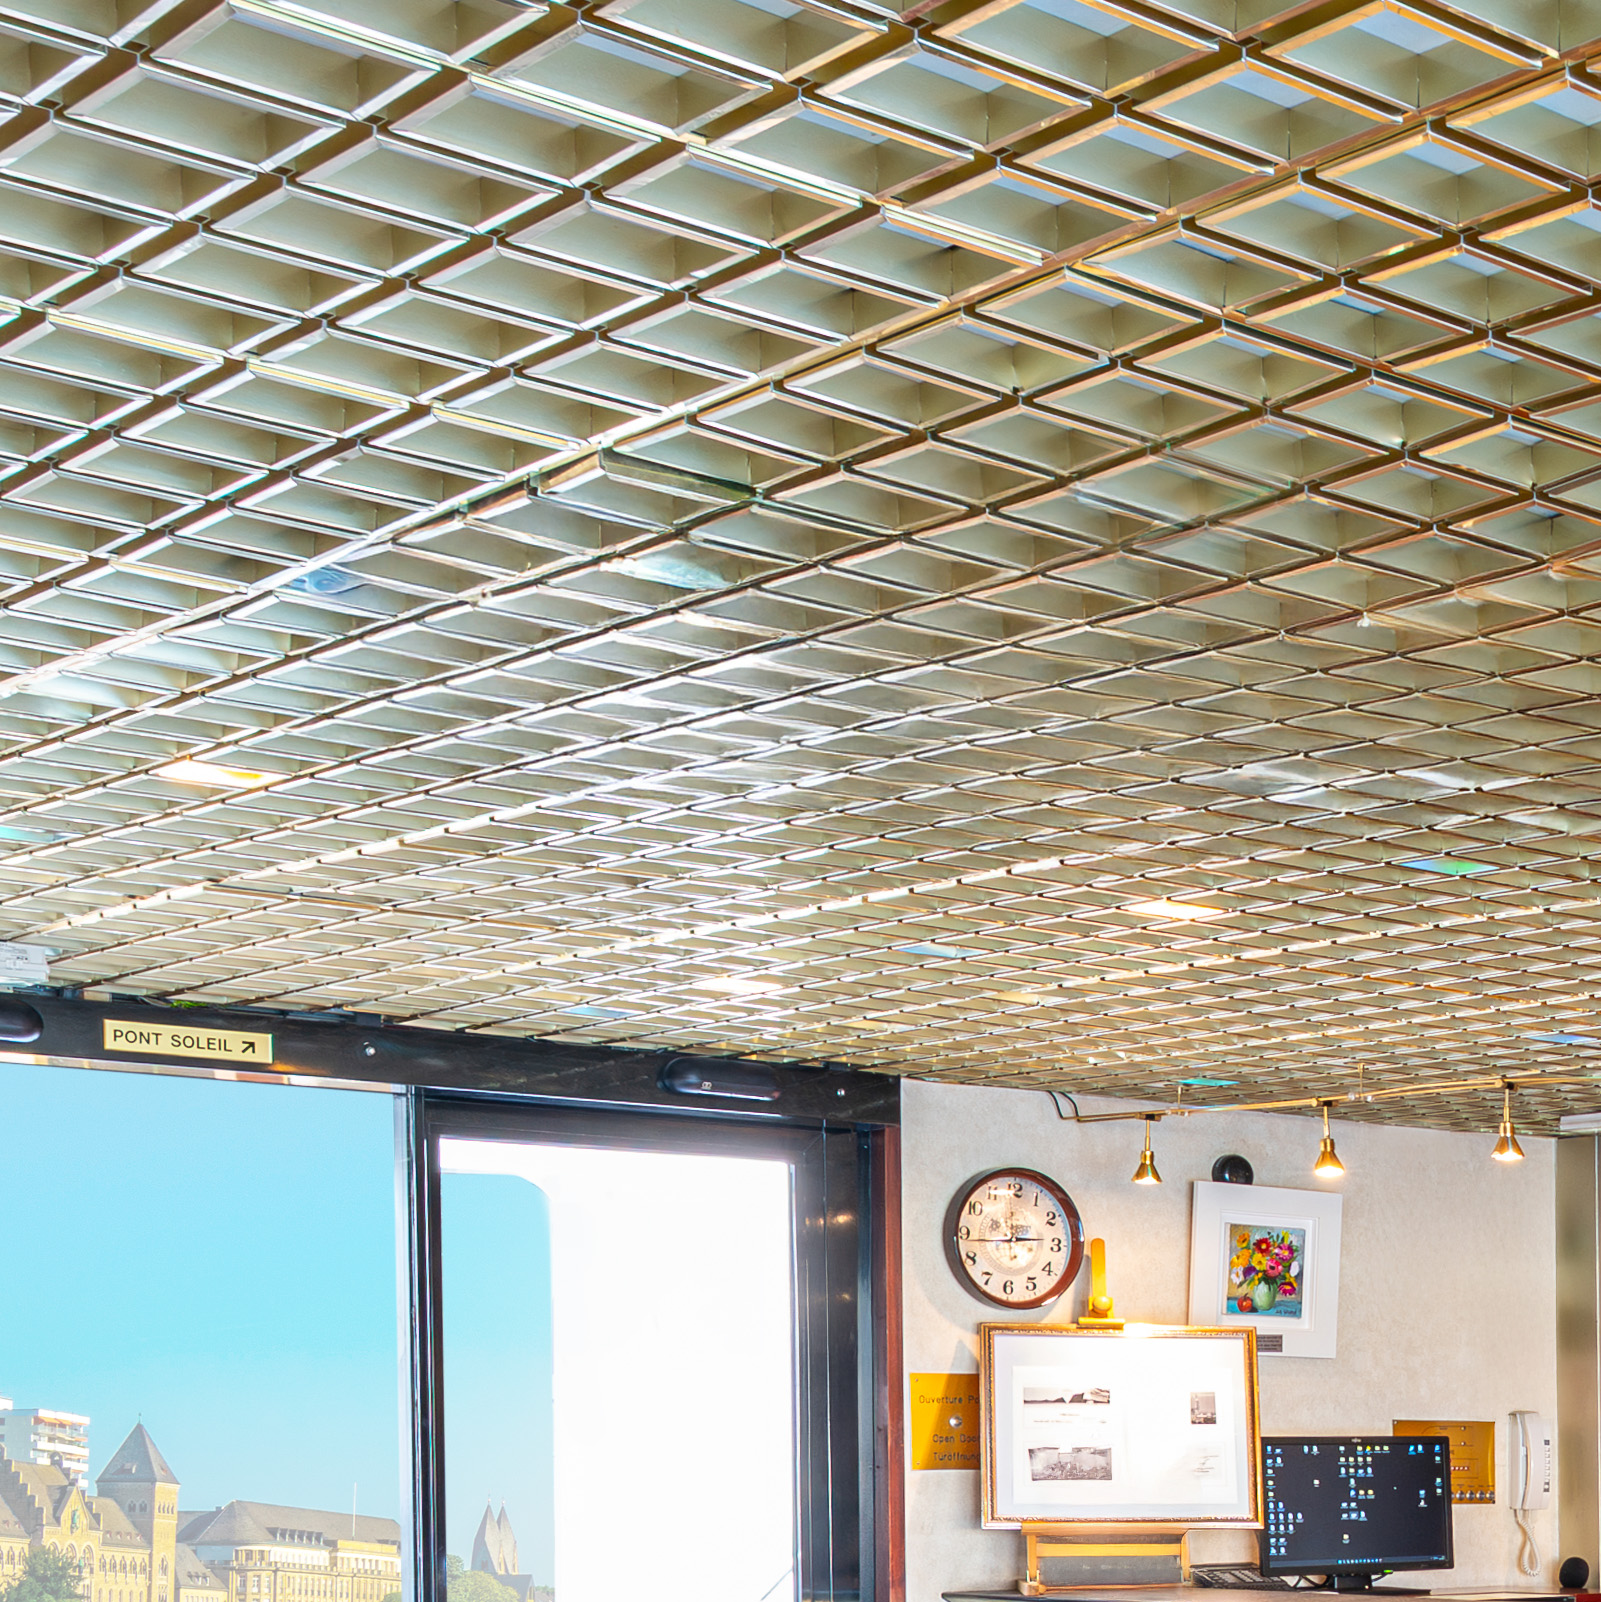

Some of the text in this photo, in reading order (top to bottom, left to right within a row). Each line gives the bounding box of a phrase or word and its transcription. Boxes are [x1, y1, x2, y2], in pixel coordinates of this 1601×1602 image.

[113, 1029, 233, 1052] PONT SOLEIL
[1033, 1192, 1039, 1207] 1
[967, 1200, 983, 1216] 10
[1046, 1211, 1056, 1227] 2
[959, 1226, 970, 1240] 9
[1050, 1238, 1062, 1252] 3
[965, 1251, 977, 1266] 8
[1041, 1261, 1053, 1276] 4
[981, 1271, 993, 1286] 7
[1026, 1276, 1037, 1291] 5
[1003, 1280, 1014, 1295] 6
[919, 1394, 963, 1404] Ouverture
[932, 1433, 955, 1445] Open
